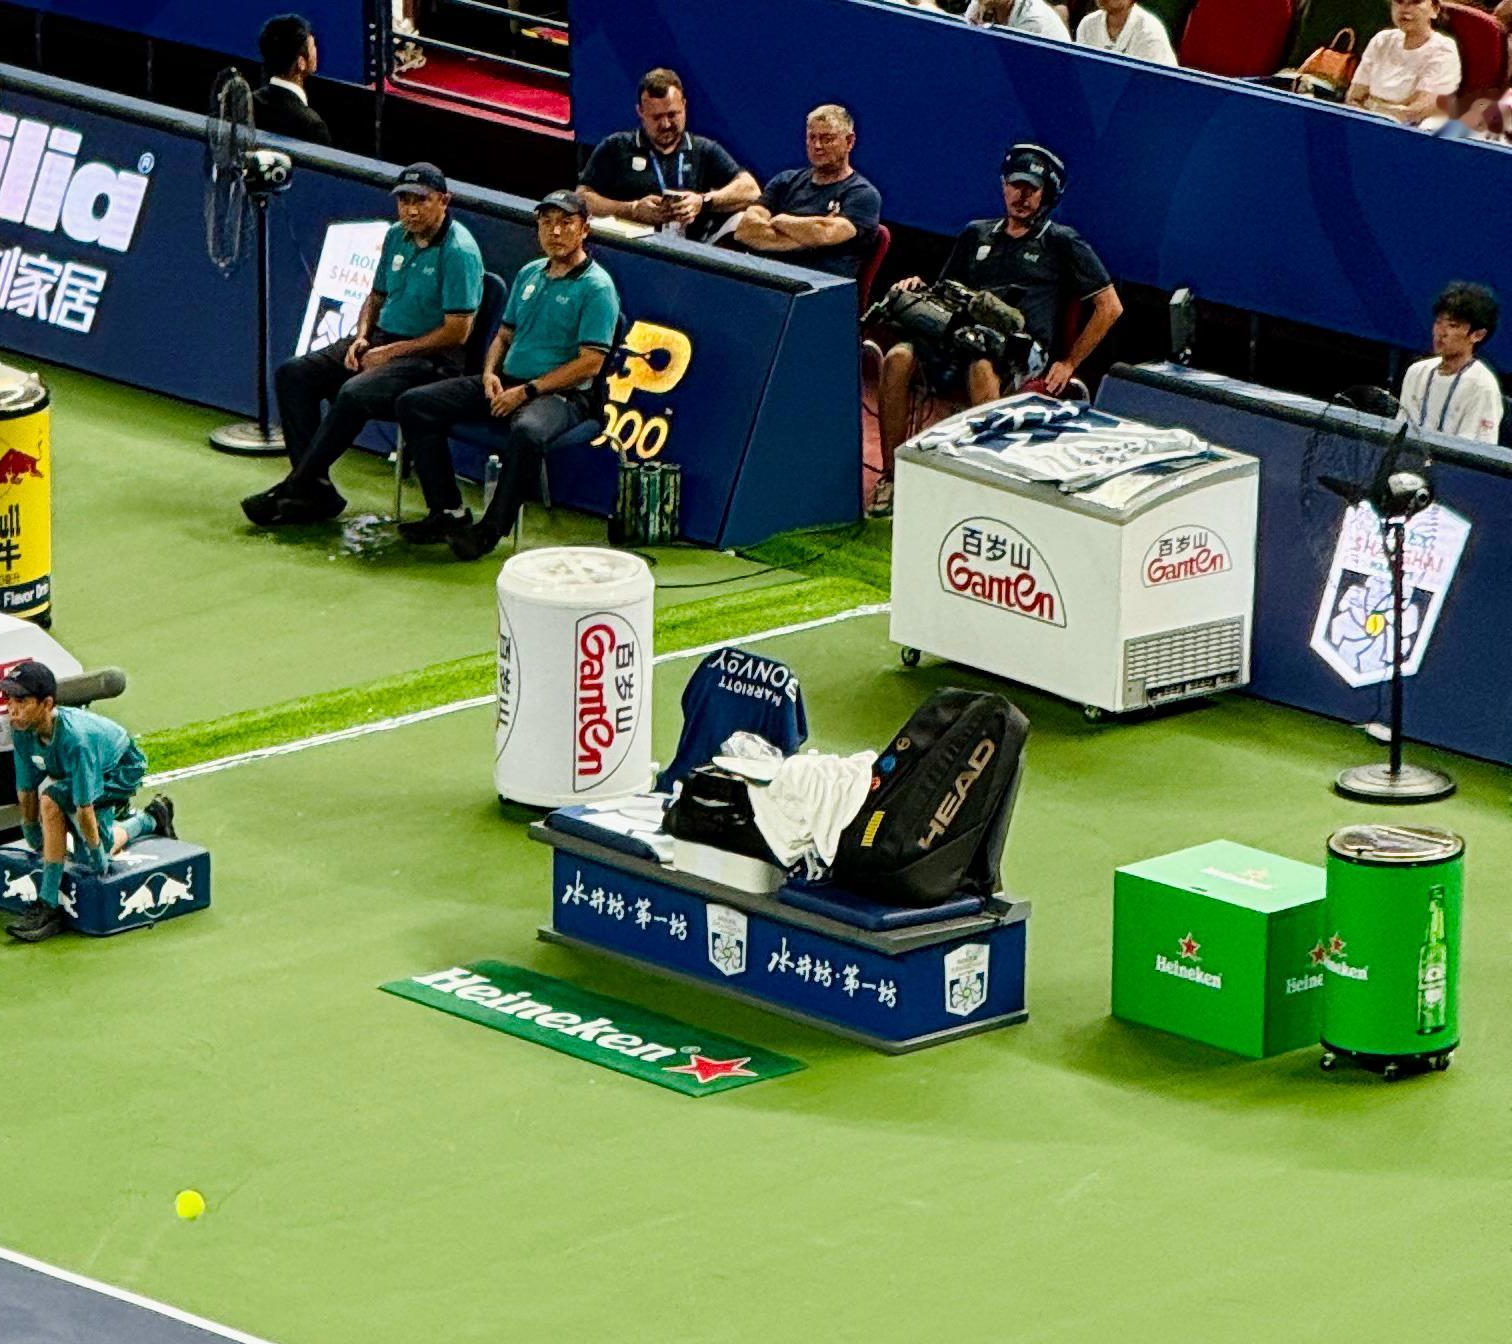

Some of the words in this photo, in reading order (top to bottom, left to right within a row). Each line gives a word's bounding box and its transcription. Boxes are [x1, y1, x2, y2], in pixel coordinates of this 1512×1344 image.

[962, 526, 1031, 571] 百岁山
[1158, 532, 1209, 557] 百岁山
[615, 641, 635, 734] 百岁山
[718, 675, 783, 707] MARRIOTT
[918, 738, 996, 848] HEAD
[1155, 953, 1223, 990] Heineken
[1286, 973, 1324, 994] Heine
[412, 967, 676, 1062] Heineken
